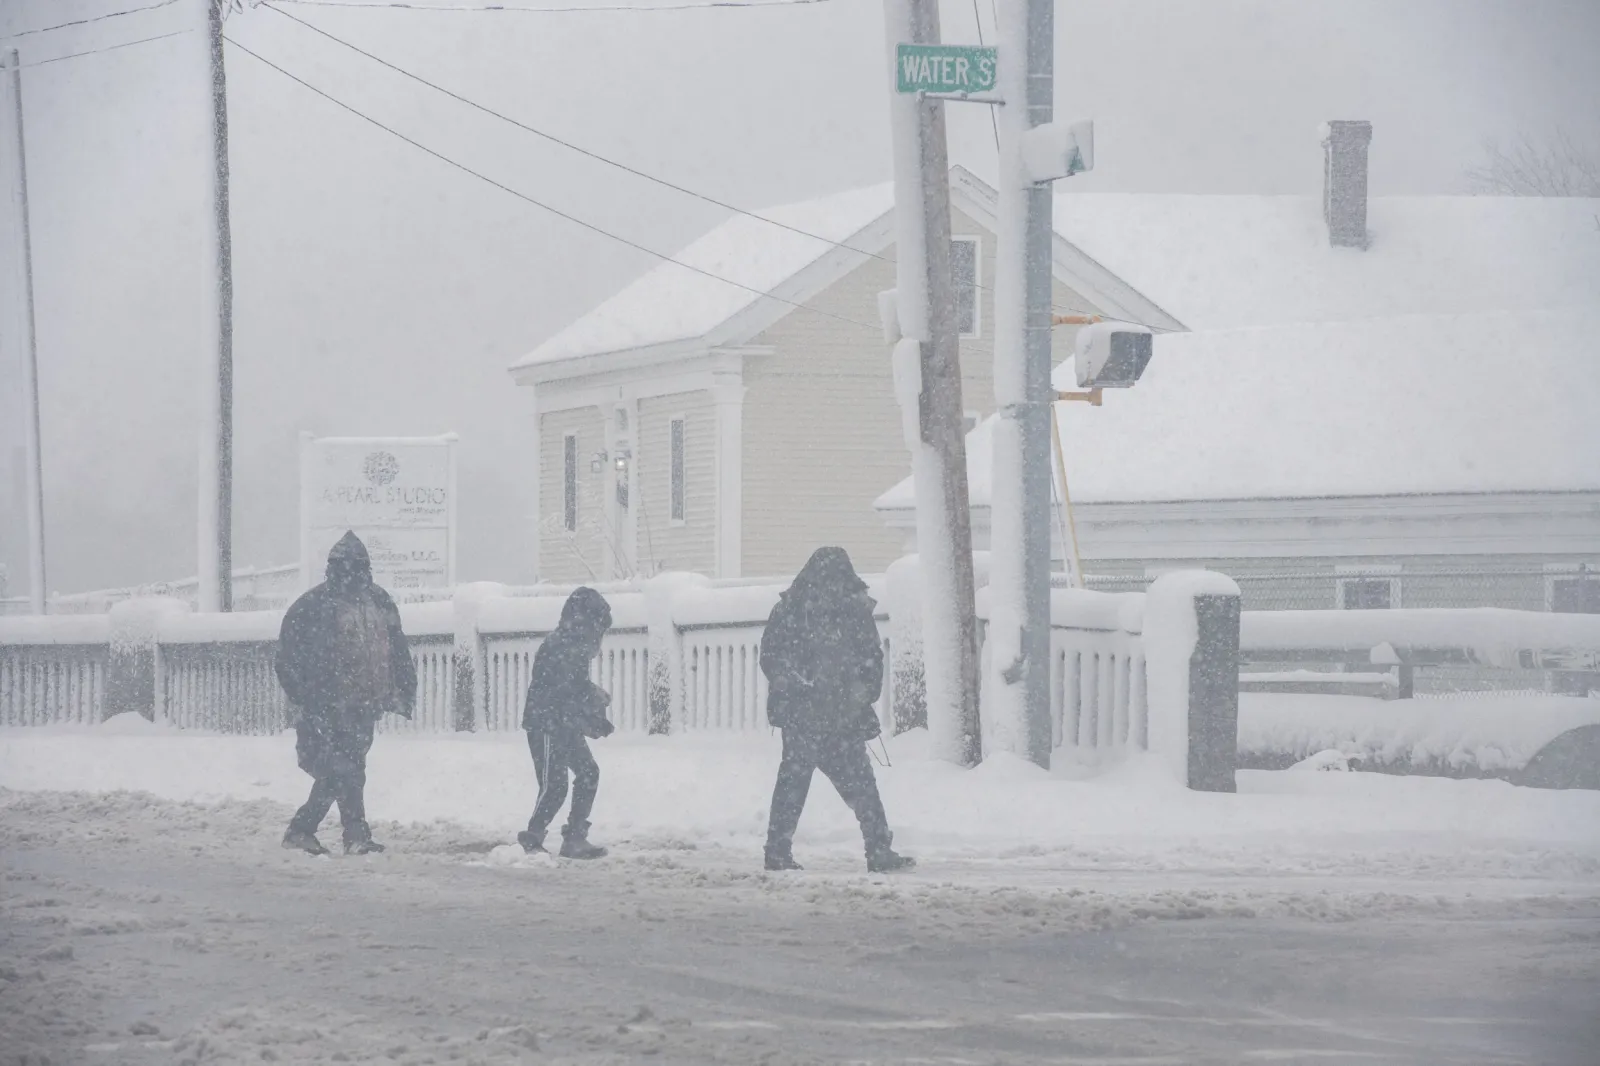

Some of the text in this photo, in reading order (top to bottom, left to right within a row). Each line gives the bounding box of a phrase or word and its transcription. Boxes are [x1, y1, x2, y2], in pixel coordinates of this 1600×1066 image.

[902, 55, 969, 86] WATER
[337, 486, 381, 503] PEARL
[386, 486, 446, 504] STUDIO
